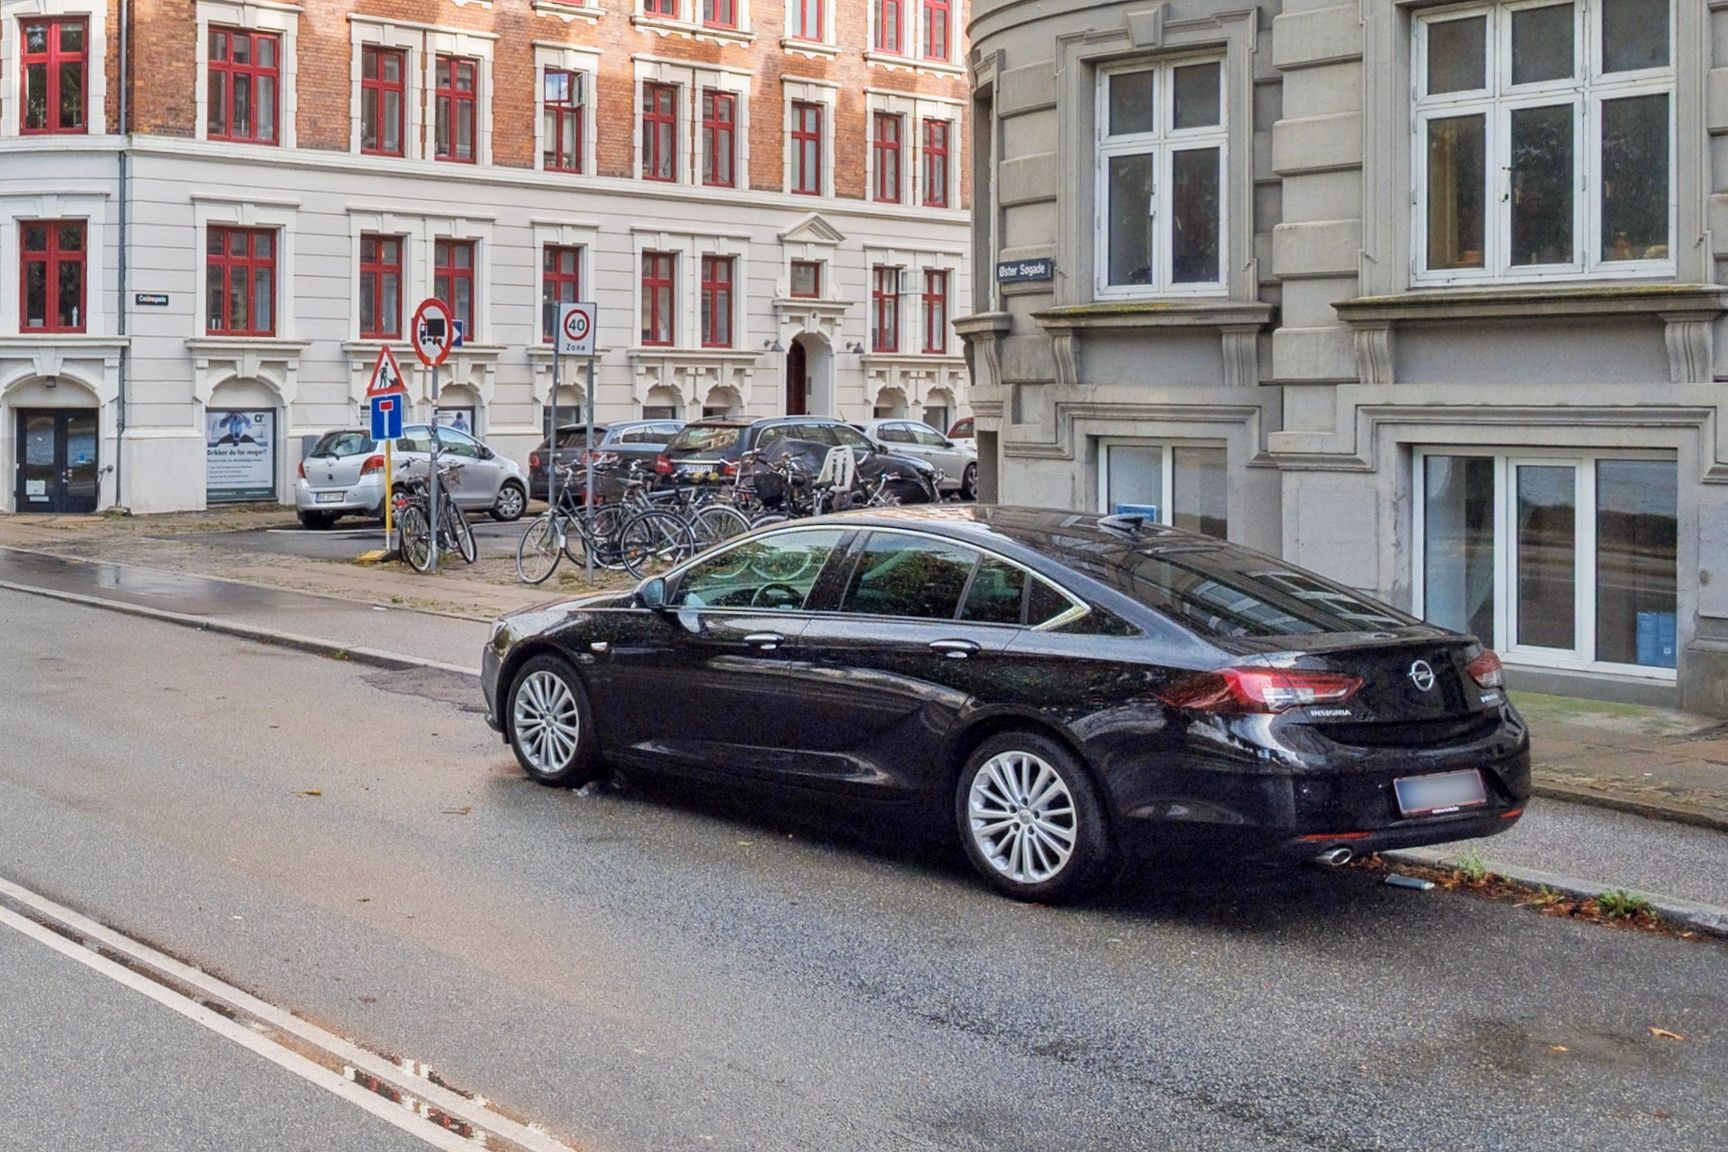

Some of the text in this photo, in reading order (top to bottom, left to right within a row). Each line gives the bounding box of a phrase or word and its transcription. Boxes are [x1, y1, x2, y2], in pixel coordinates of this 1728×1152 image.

[999, 265, 1017, 277] Øster
[1020, 262, 1045, 276] Søgade
[568, 319, 585, 331] 40
[566, 342, 585, 351] Zone
[1310, 709, 1352, 717] INSIGNIA
